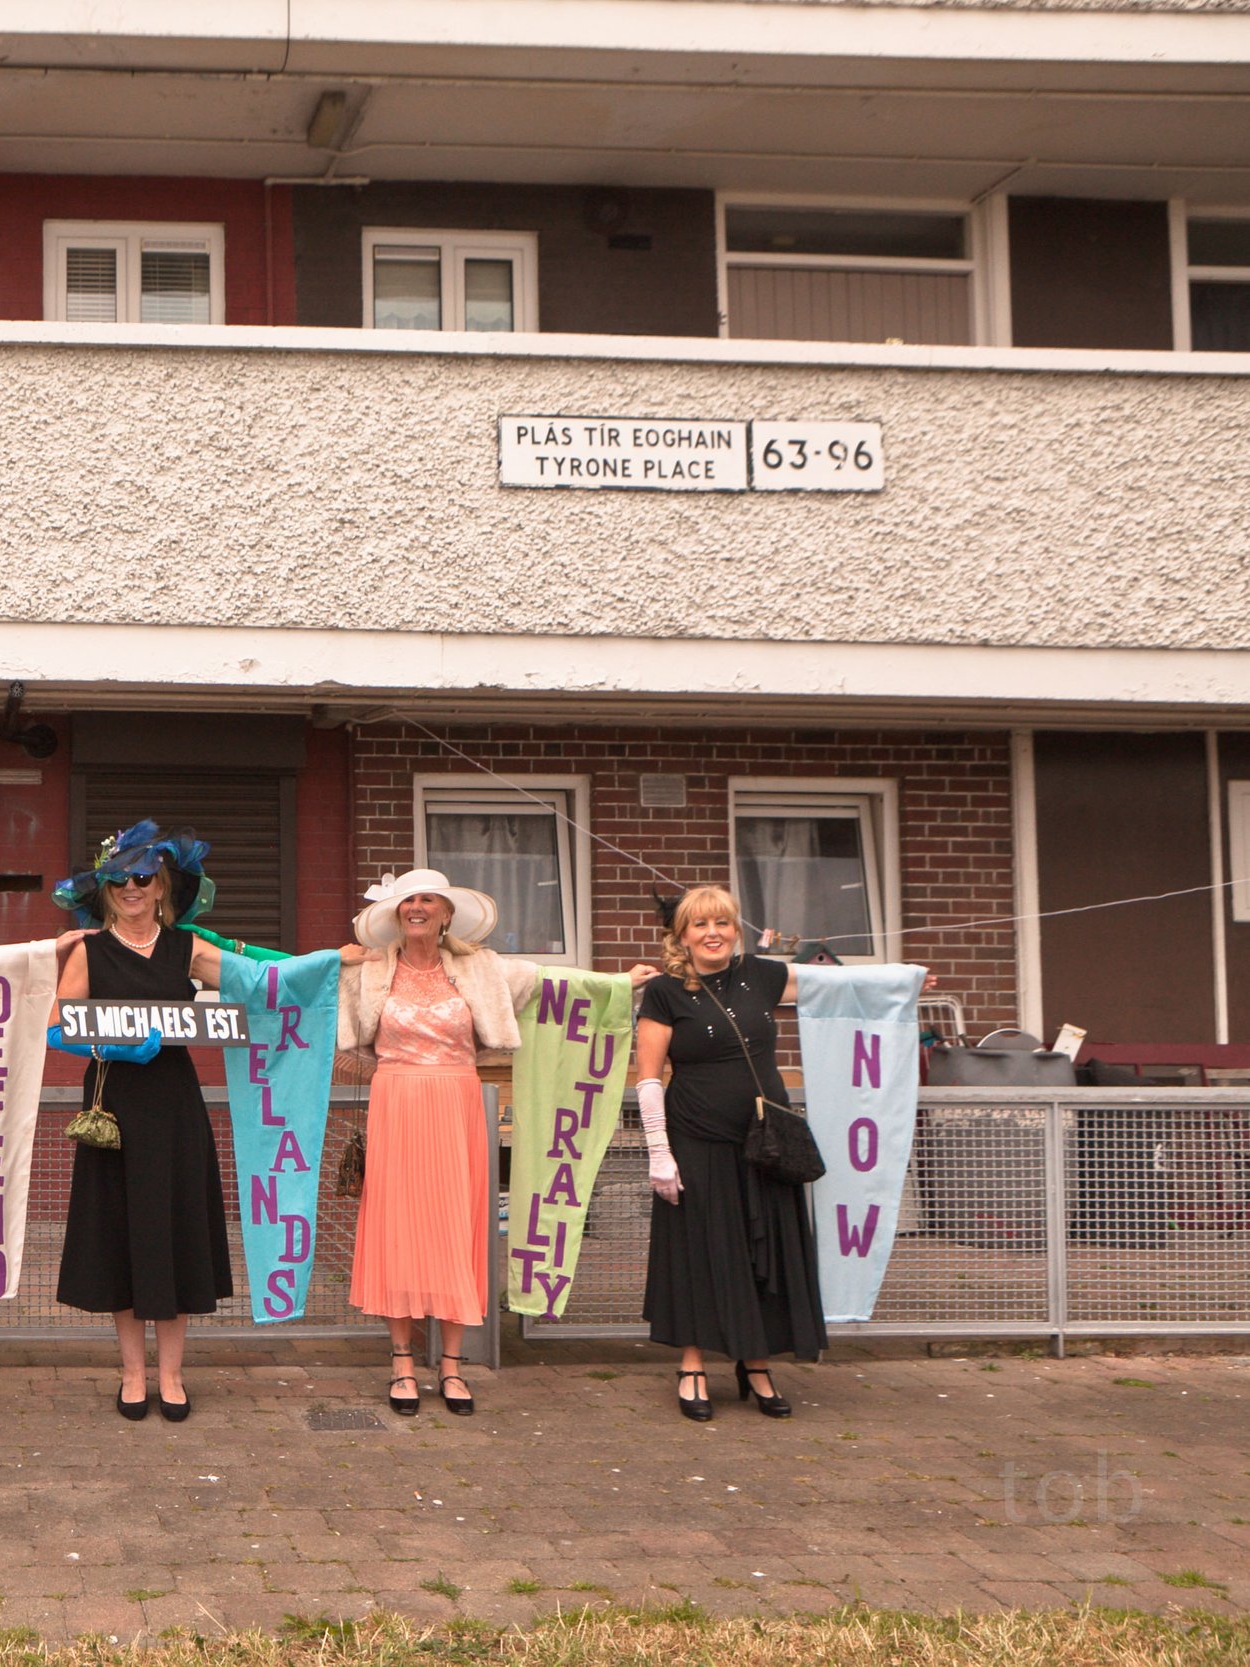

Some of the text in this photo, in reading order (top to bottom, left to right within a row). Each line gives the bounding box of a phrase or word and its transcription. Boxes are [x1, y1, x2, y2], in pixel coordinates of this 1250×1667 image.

[516, 421, 732, 450] PLÁS TÍR EOGHAIN
[535, 456, 716, 480] TYRONE PLACE
[762, 439, 874, 471] 63-96
[61, 1004, 246, 1040] ST. MICHAELS EST.
[249, 966, 312, 1320] IRELANDS
[512, 978, 614, 1321] NEUTRALITY
[836, 1030, 882, 1258] NOW
